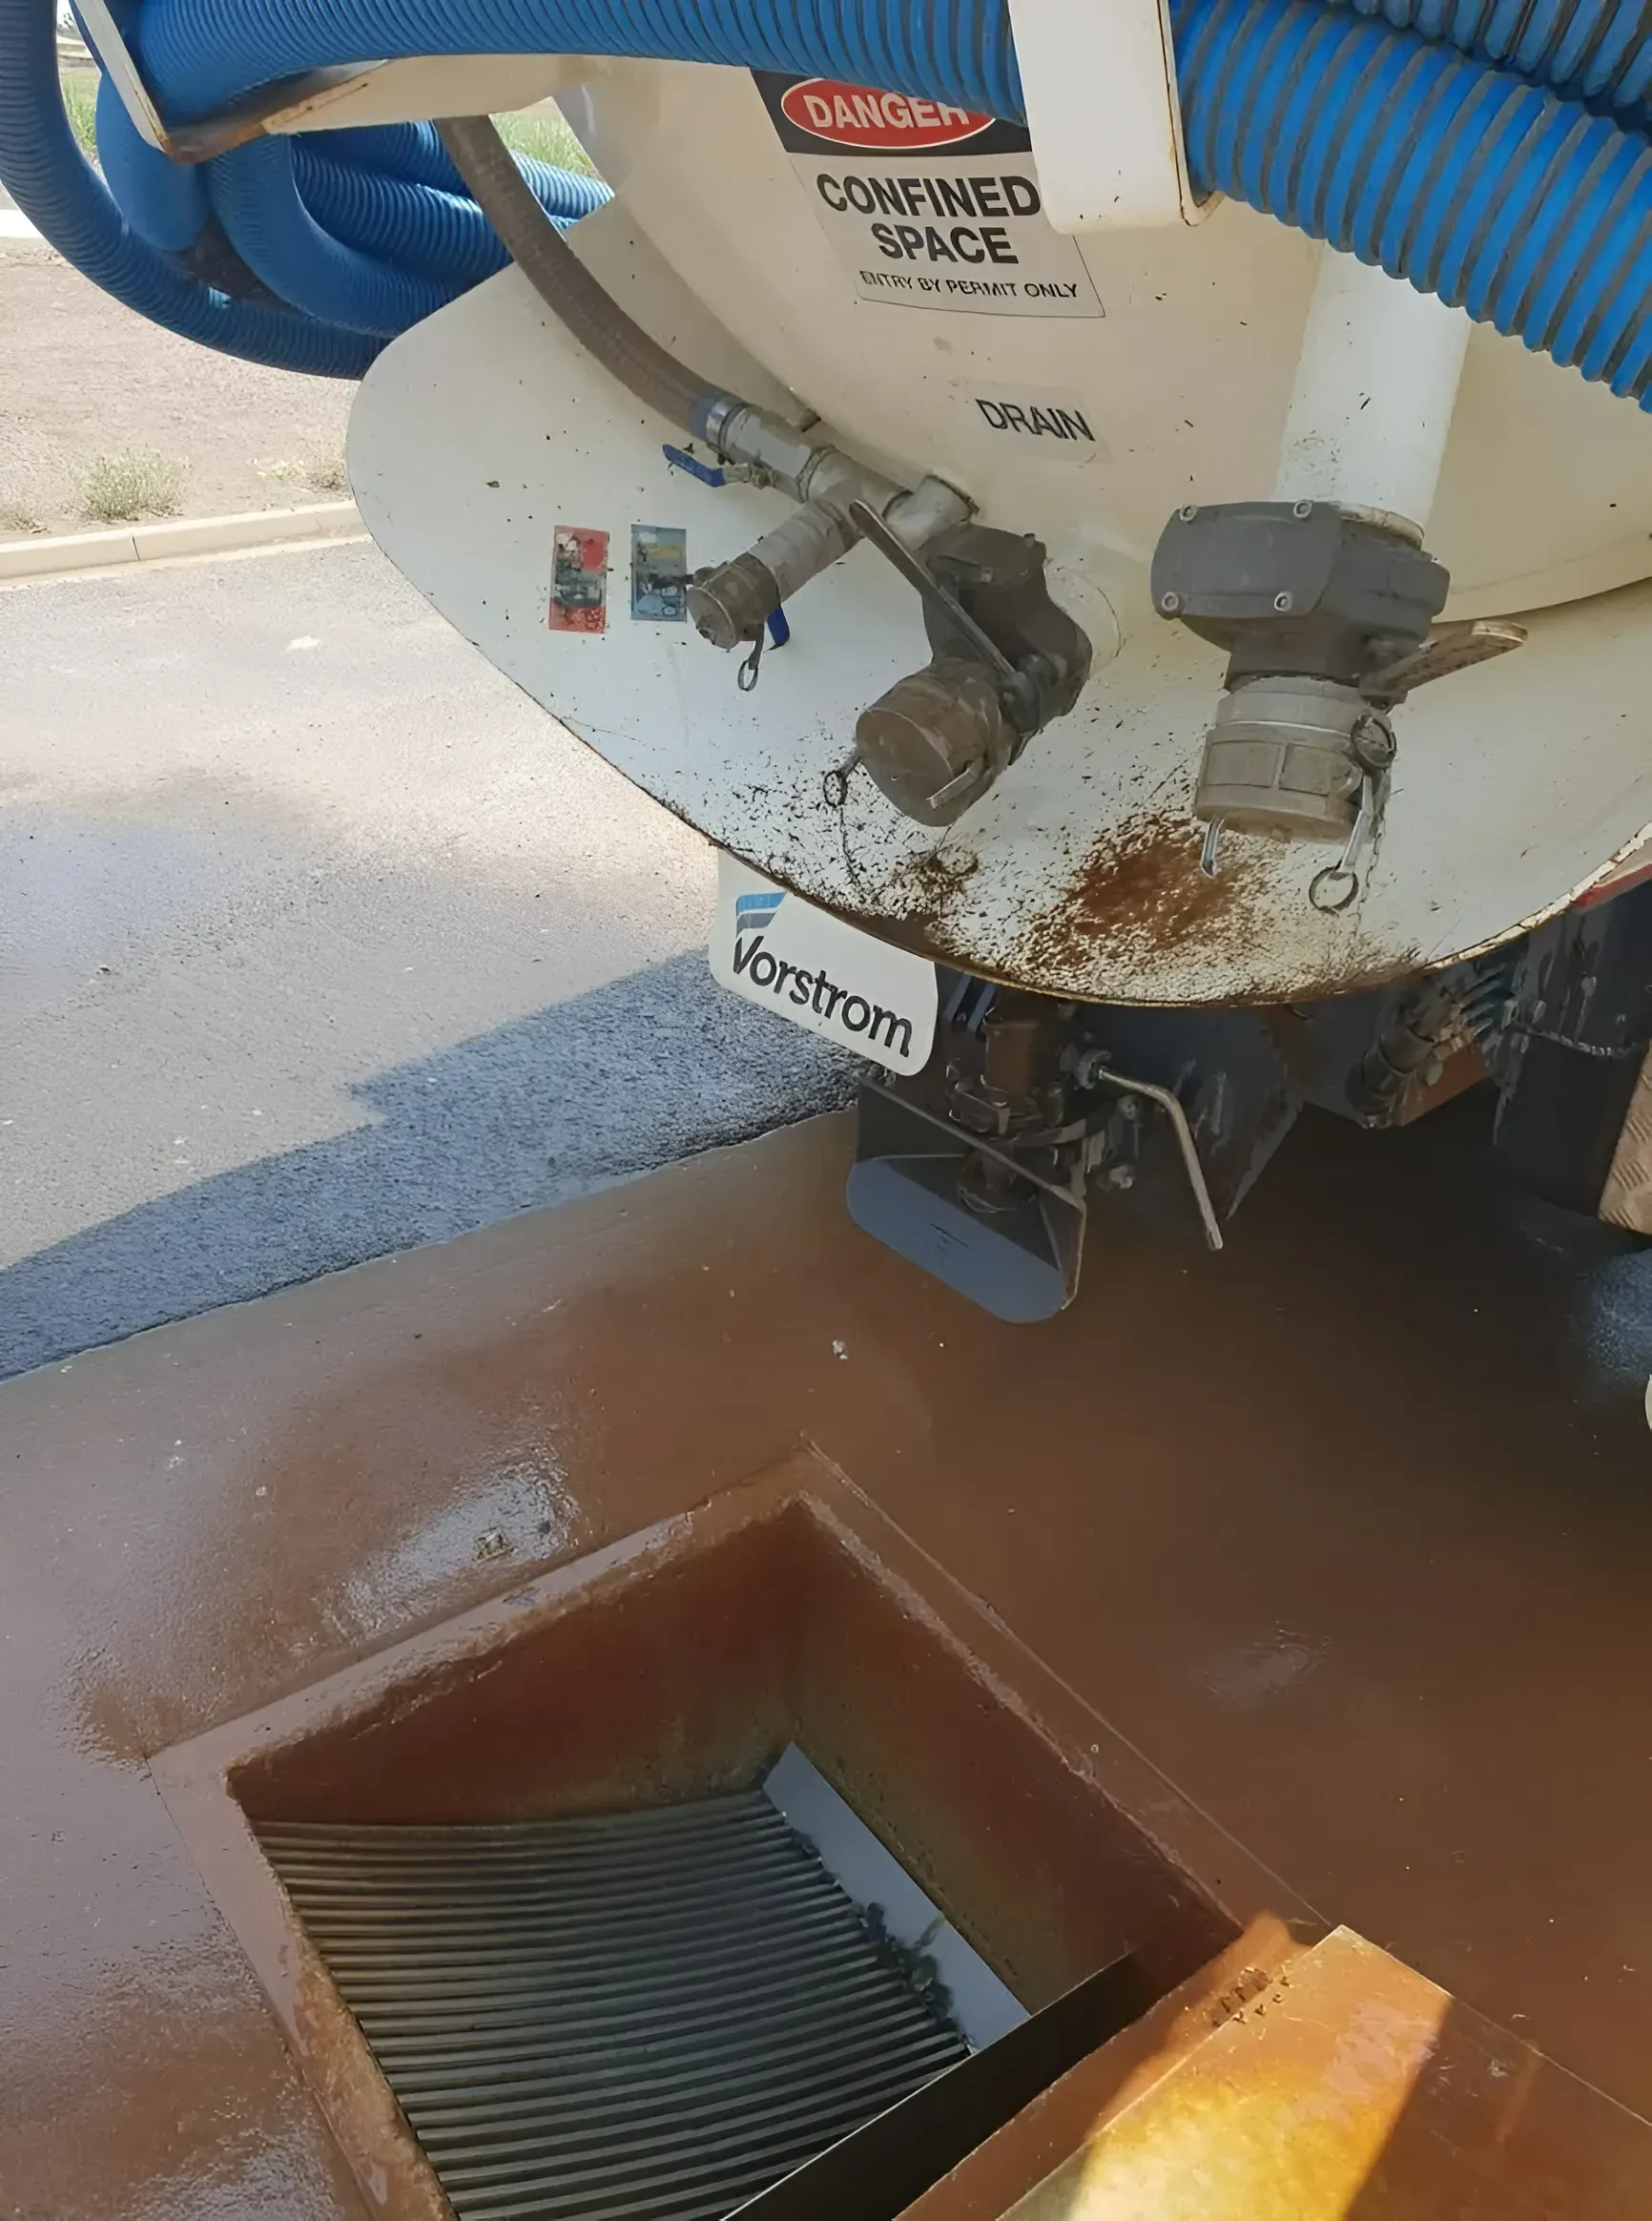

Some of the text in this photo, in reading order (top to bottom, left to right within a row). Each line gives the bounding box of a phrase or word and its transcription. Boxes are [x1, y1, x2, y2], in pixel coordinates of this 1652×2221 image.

[816, 173, 1042, 218] CONFINED
[871, 222, 1020, 264] SPACE
[859, 270, 1078, 299] ENTRY BY PERMIT ONLY
[975, 398, 1097, 442] DRAIN
[733, 935, 913, 1058] Vorstrom
